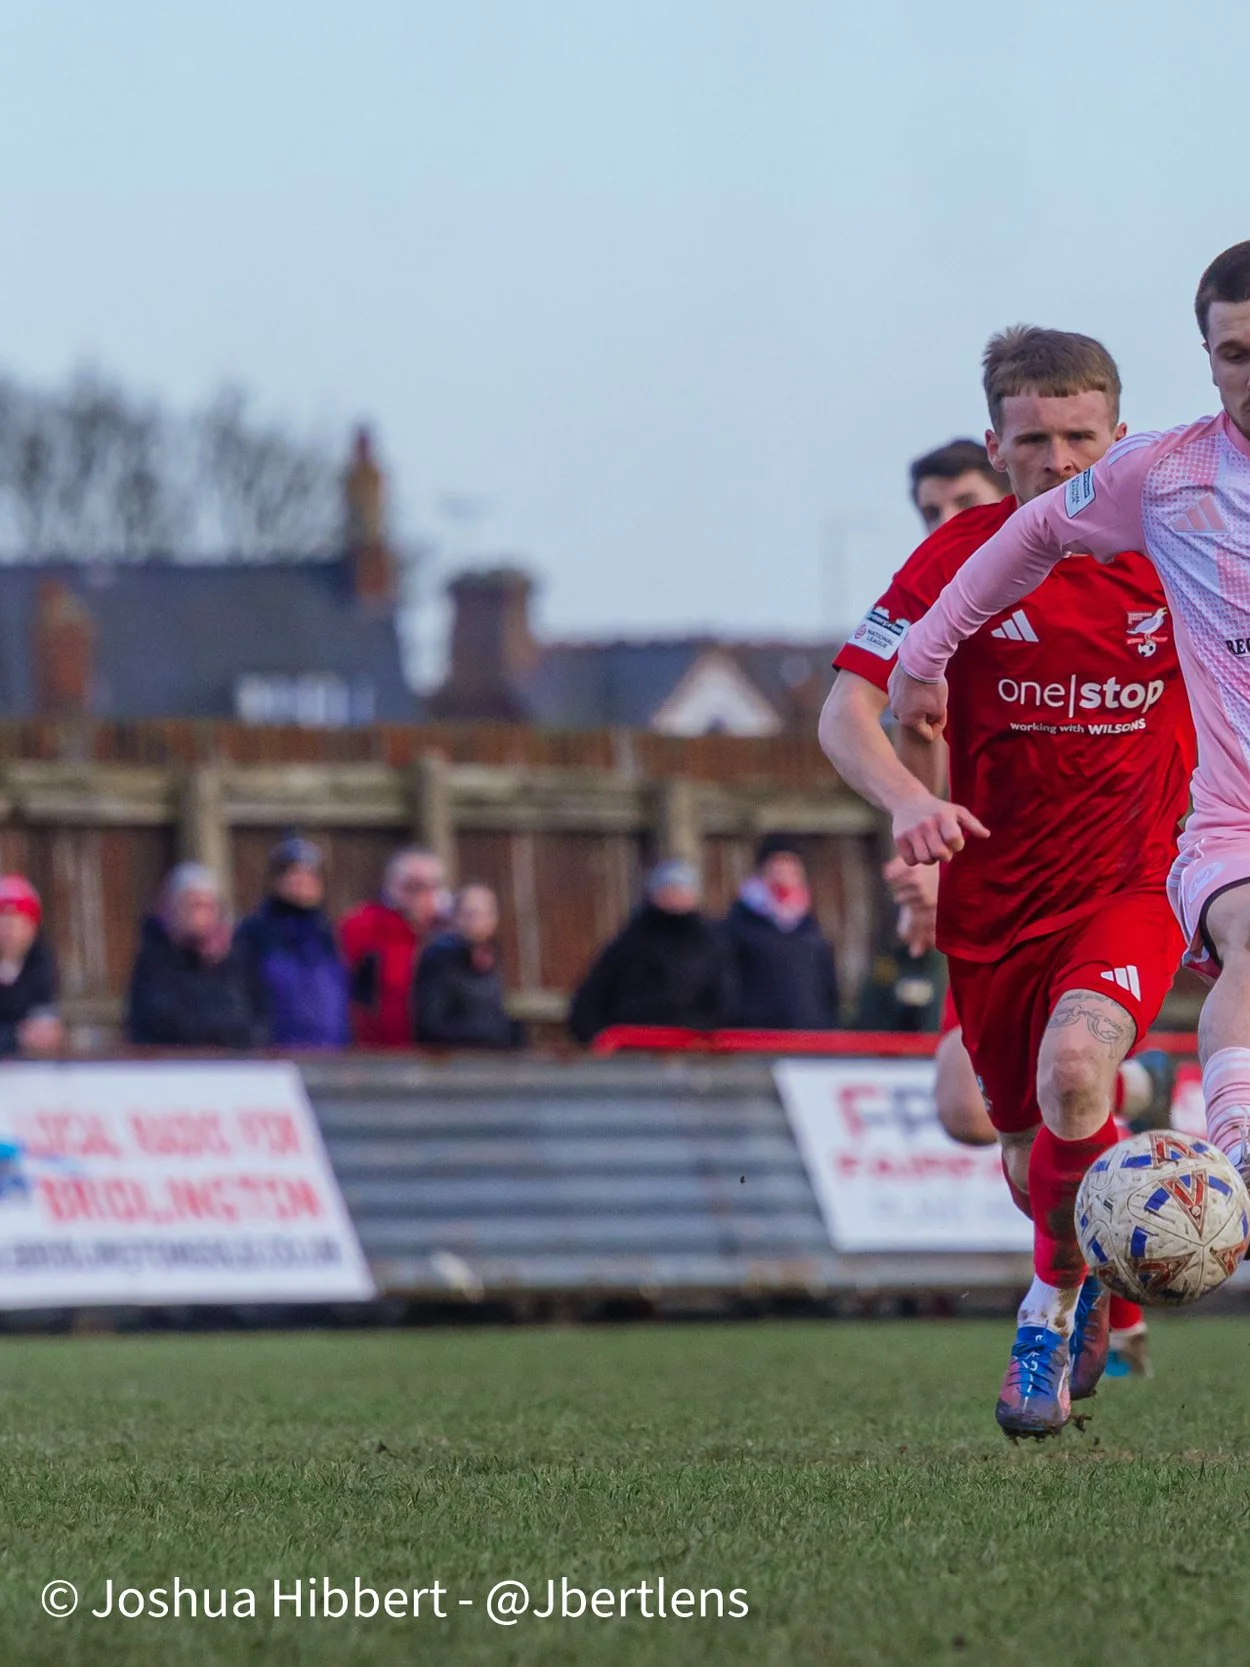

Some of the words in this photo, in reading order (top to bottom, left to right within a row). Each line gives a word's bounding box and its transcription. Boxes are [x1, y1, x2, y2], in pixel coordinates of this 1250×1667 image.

[1009, 722, 1057, 734] working
[1059, 726, 1086, 734] with
[1087, 718, 1147, 736] WILSONS
